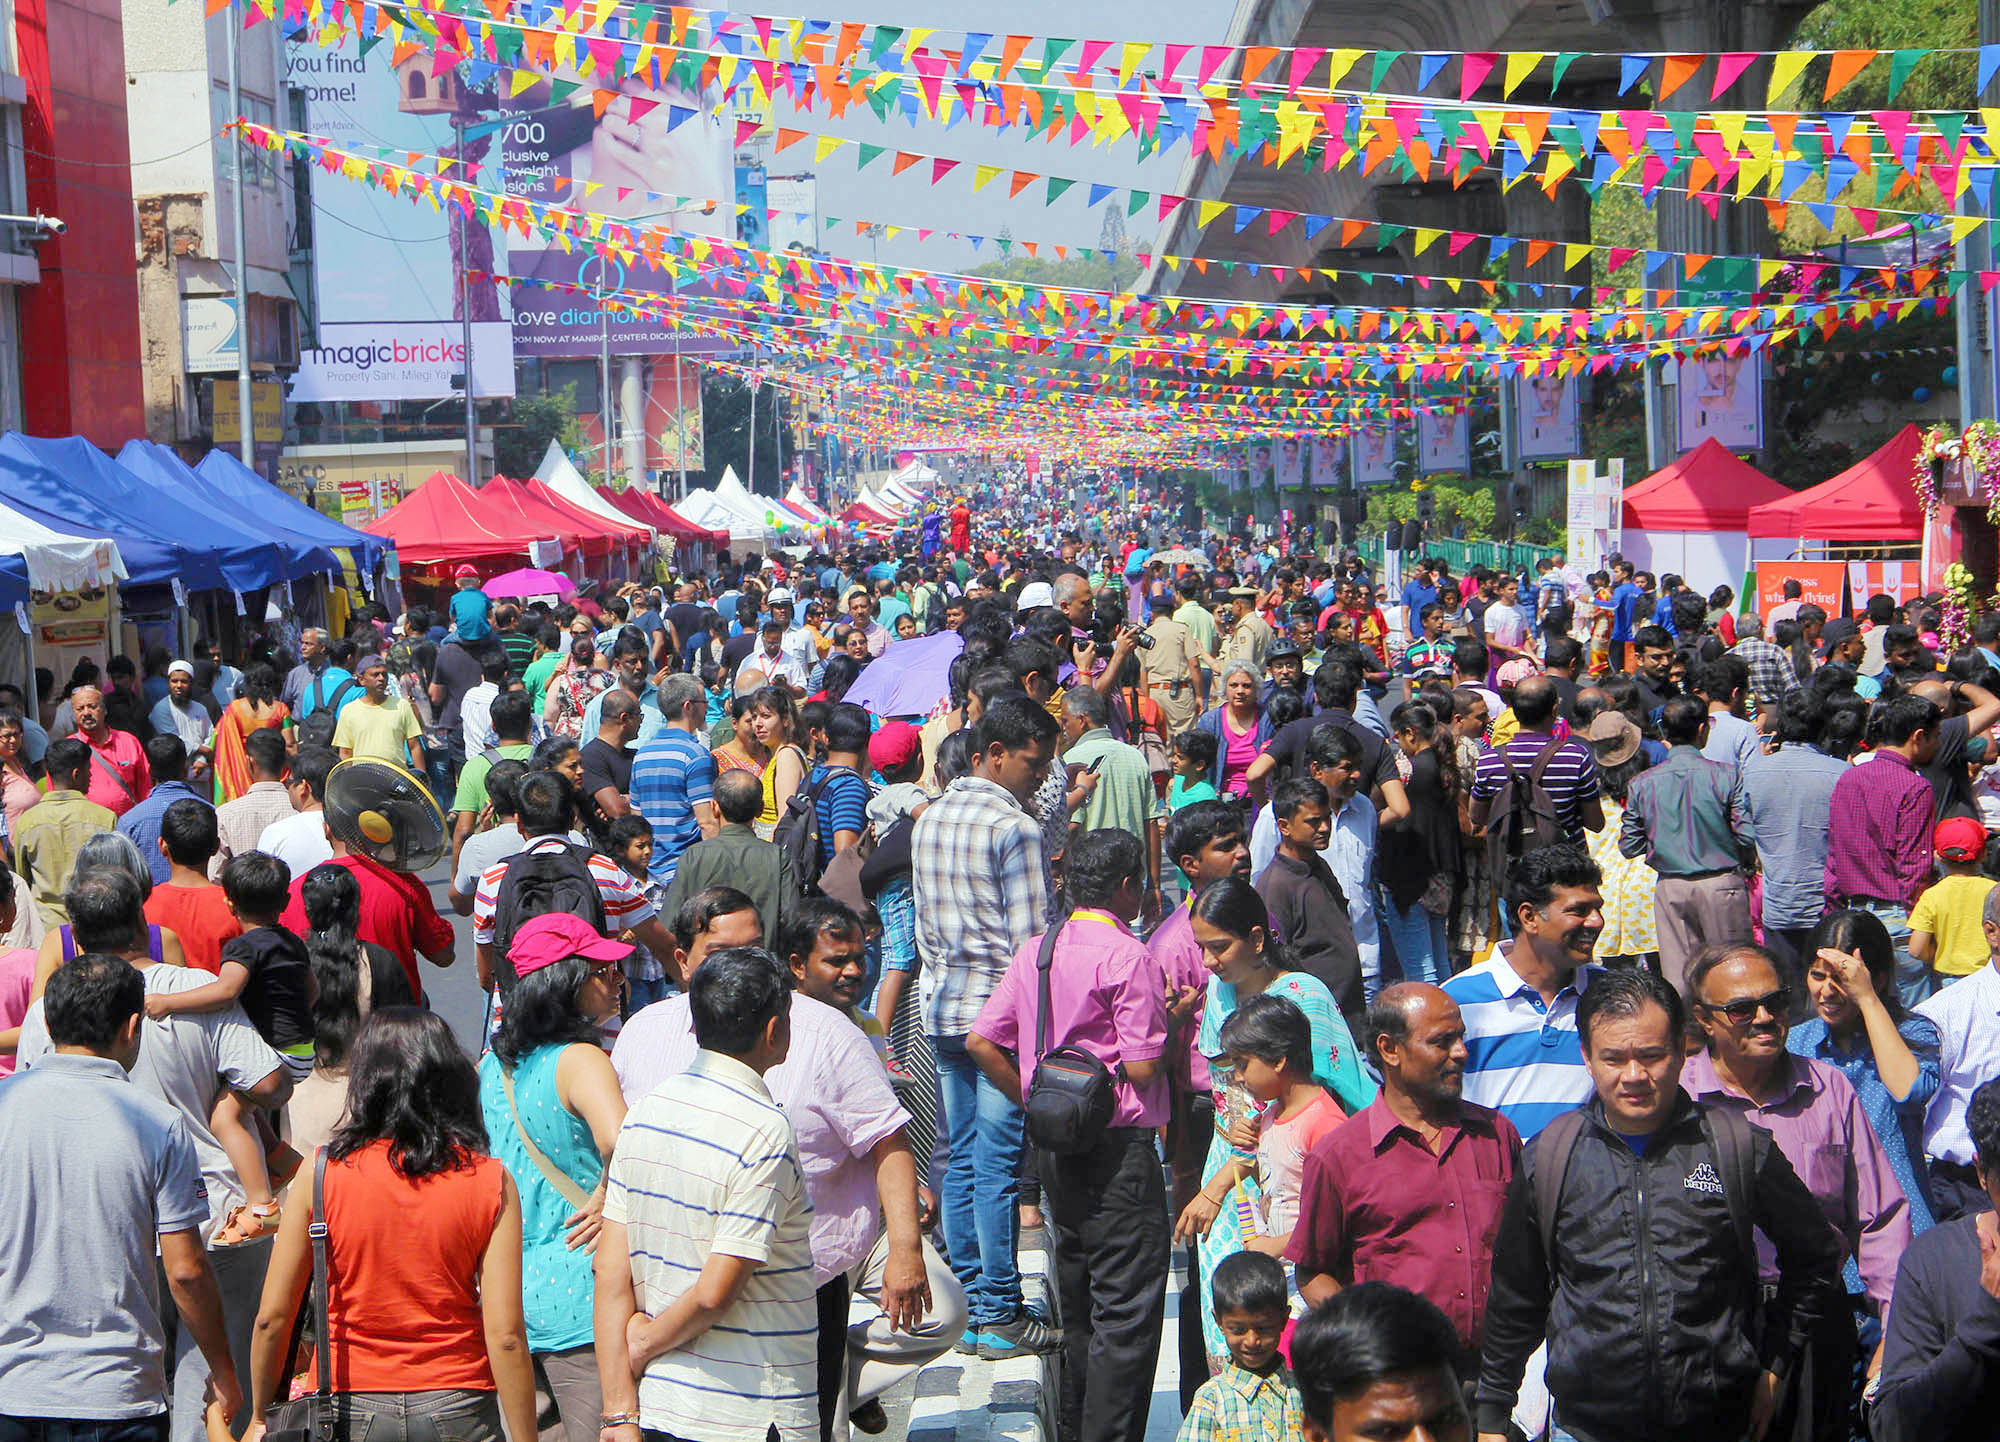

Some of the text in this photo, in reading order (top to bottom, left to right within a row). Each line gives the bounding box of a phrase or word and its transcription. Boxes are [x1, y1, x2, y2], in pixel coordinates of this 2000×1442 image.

[286, 52, 366, 77] you find
[303, 82, 356, 101] ome!
[499, 108, 531, 121] Ove
[502, 122, 545, 144] 700
[504, 180, 547, 195] signs.
[511, 308, 557, 326] love
[559, 335, 570, 343] AT
[572, 335, 611, 343] MANIPA
[313, 338, 466, 370] magicbricks
[327, 370, 370, 384] Property
[1804, 592, 1836, 606] flying
